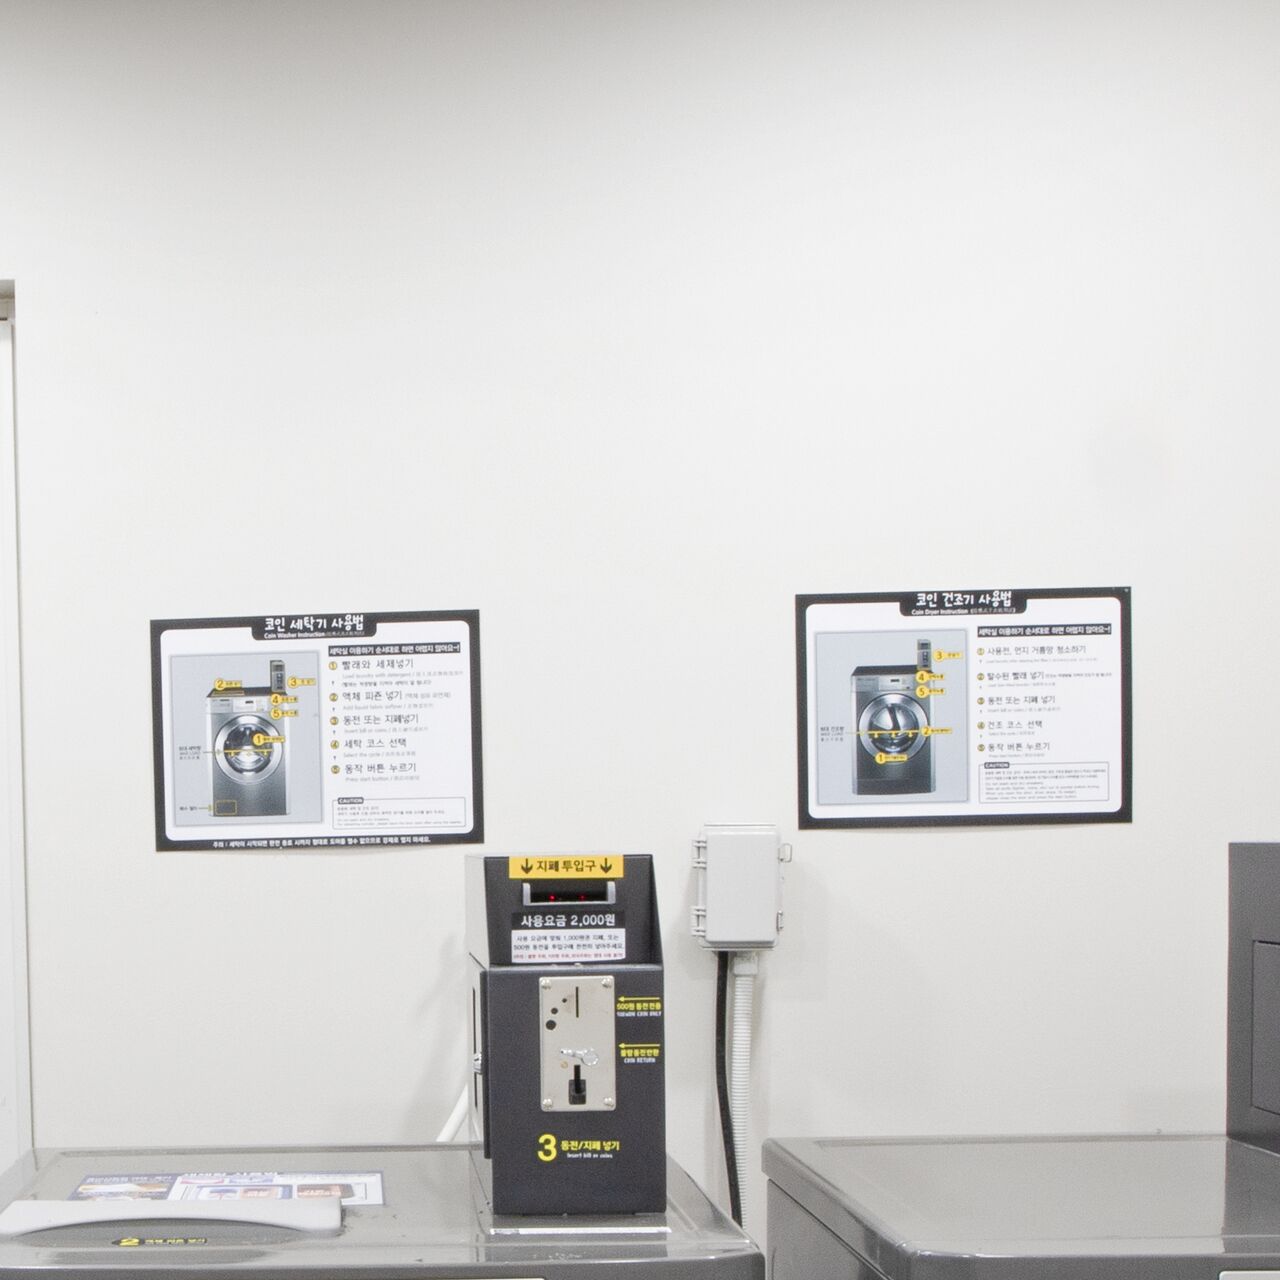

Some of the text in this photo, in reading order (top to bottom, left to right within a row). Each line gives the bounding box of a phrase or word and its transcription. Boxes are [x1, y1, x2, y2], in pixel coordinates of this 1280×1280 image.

[916, 591, 1012, 607] 코인 건조기 사용법
[265, 614, 364, 632] 코인 세탁기 사용법
[537, 860, 596, 872] 지폐 투입구
[521, 914, 616, 927] 사용요금 2,000원
[538, 1134, 557, 1162] 3
